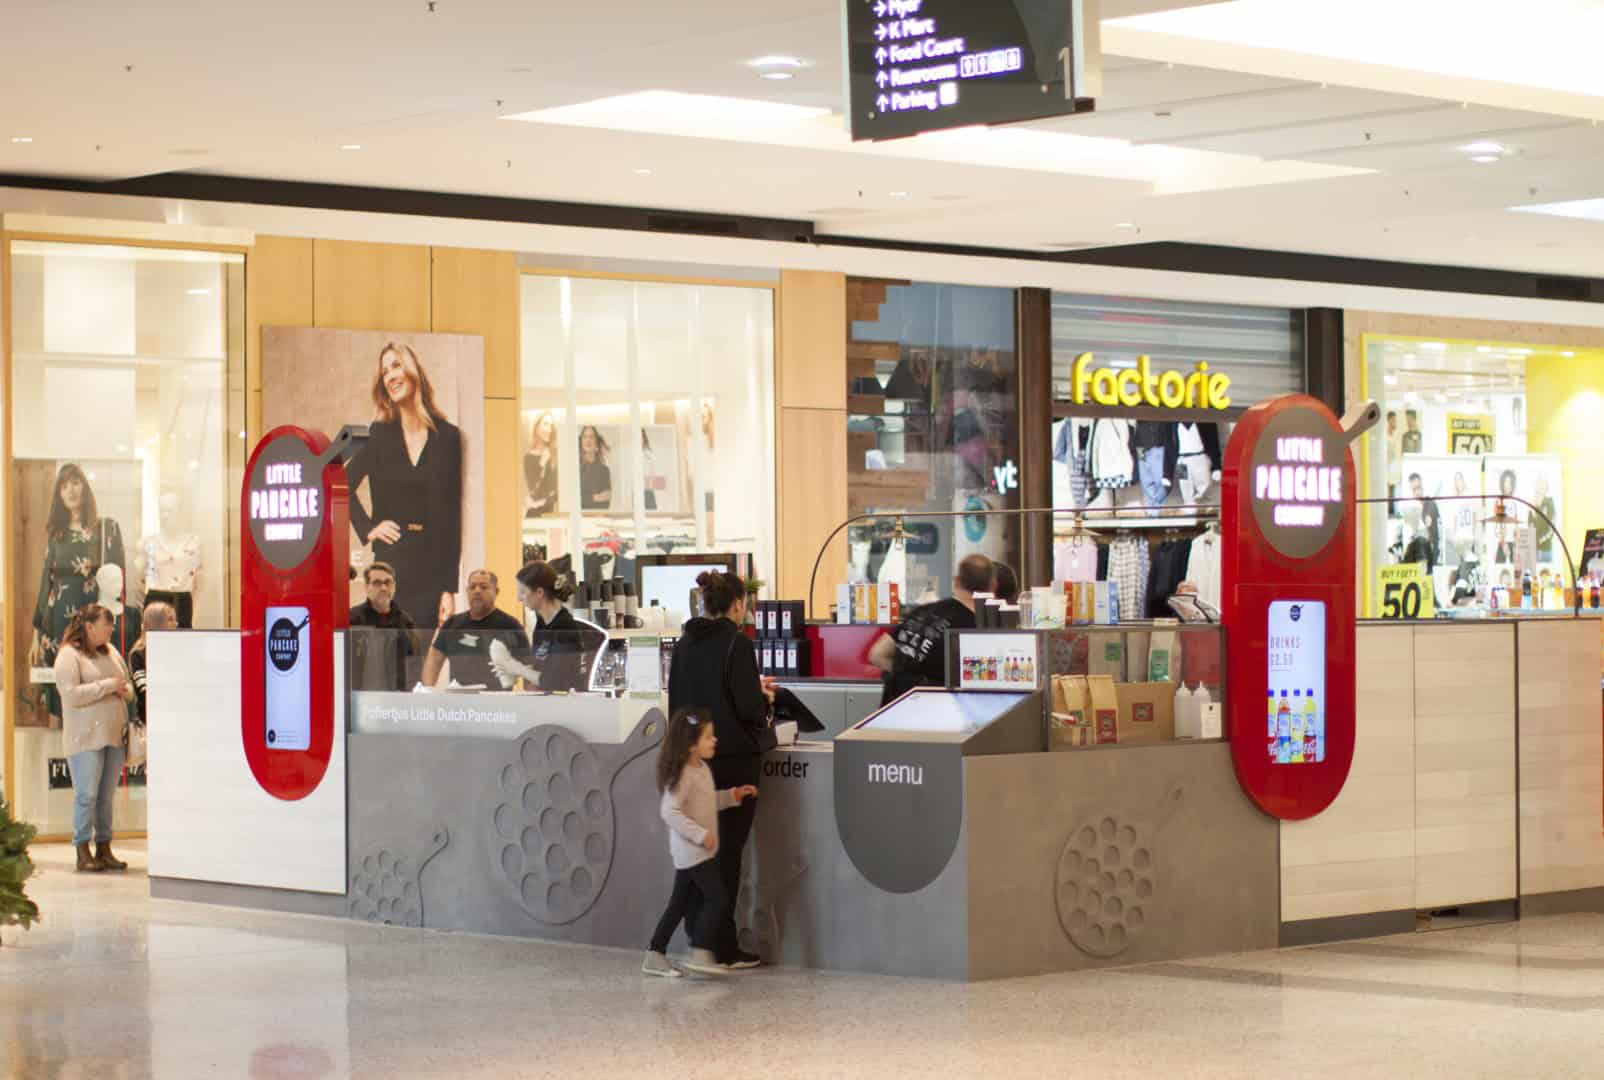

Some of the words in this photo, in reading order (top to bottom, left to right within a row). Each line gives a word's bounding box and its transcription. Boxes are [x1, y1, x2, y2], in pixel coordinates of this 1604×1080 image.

[889, 21, 901, 39] K
[890, 41, 922, 63] Food
[1058, 47, 1072, 100] 1
[1071, 351, 1232, 410] factorie
[265, 463, 302, 485] LITTLE
[1382, 582, 1421, 619] 50
[437, 705, 466, 721] Dutch
[763, 755, 809, 778] order
[868, 763, 923, 785] menu
